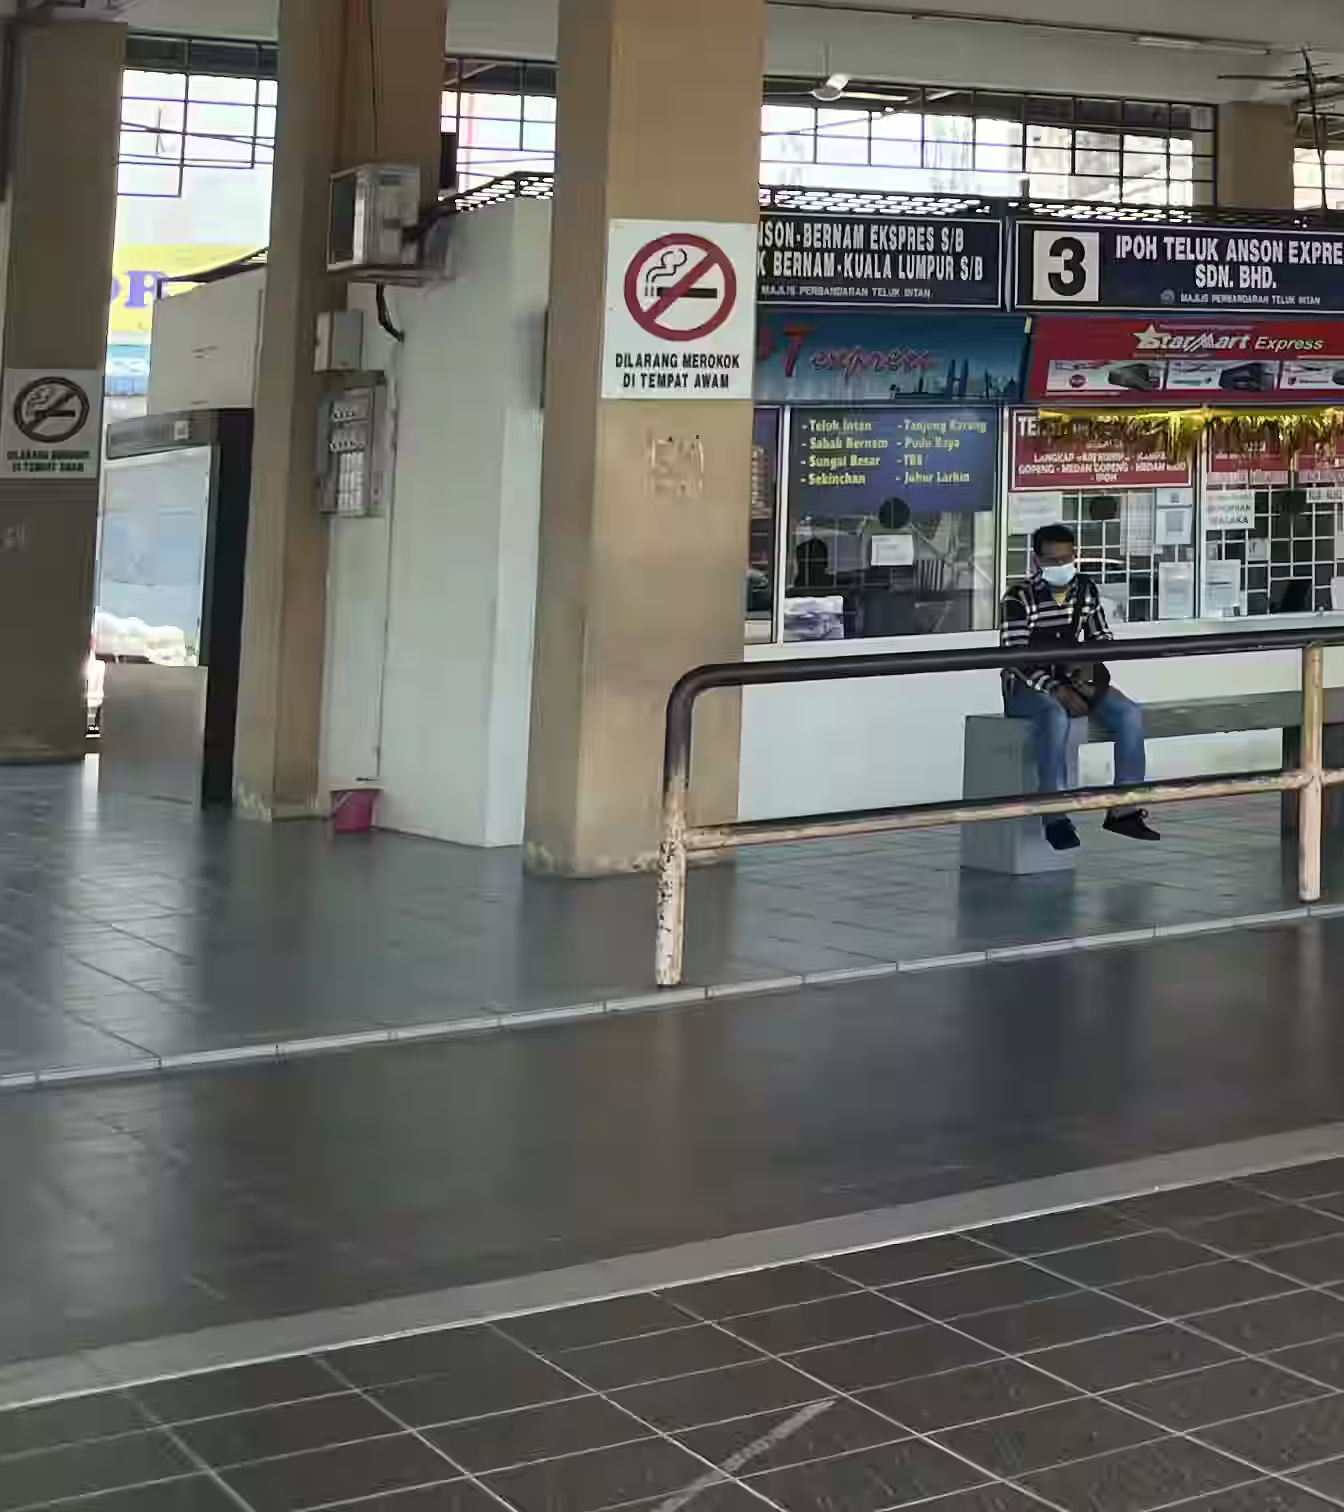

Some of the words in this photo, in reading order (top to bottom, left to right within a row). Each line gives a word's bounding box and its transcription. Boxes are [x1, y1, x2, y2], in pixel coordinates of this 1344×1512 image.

[869, 225, 935, 252] EKSPRES
[940, 227, 964, 253] S/B
[1115, 235, 1158, 260] IPOH
[1164, 236, 1219, 262] TELUK
[1226, 238, 1283, 263] ANSON
[773, 252, 892, 279] BERNAM-KUALA
[898, 255, 955, 281] LUMPUR
[959, 256, 984, 281] S/B
[1047, 236, 1087, 296] 3
[1195, 265, 1234, 288] SDN.
[1239, 266, 1277, 289] BHD.
[1254, 336, 1324, 352] Express
[615, 352, 678, 369] DILARANG
[682, 353, 740, 369] MEROKOK
[623, 372, 635, 388] DI
[640, 372, 688, 389] TEMPAT
[693, 373, 729, 389] AWAM
